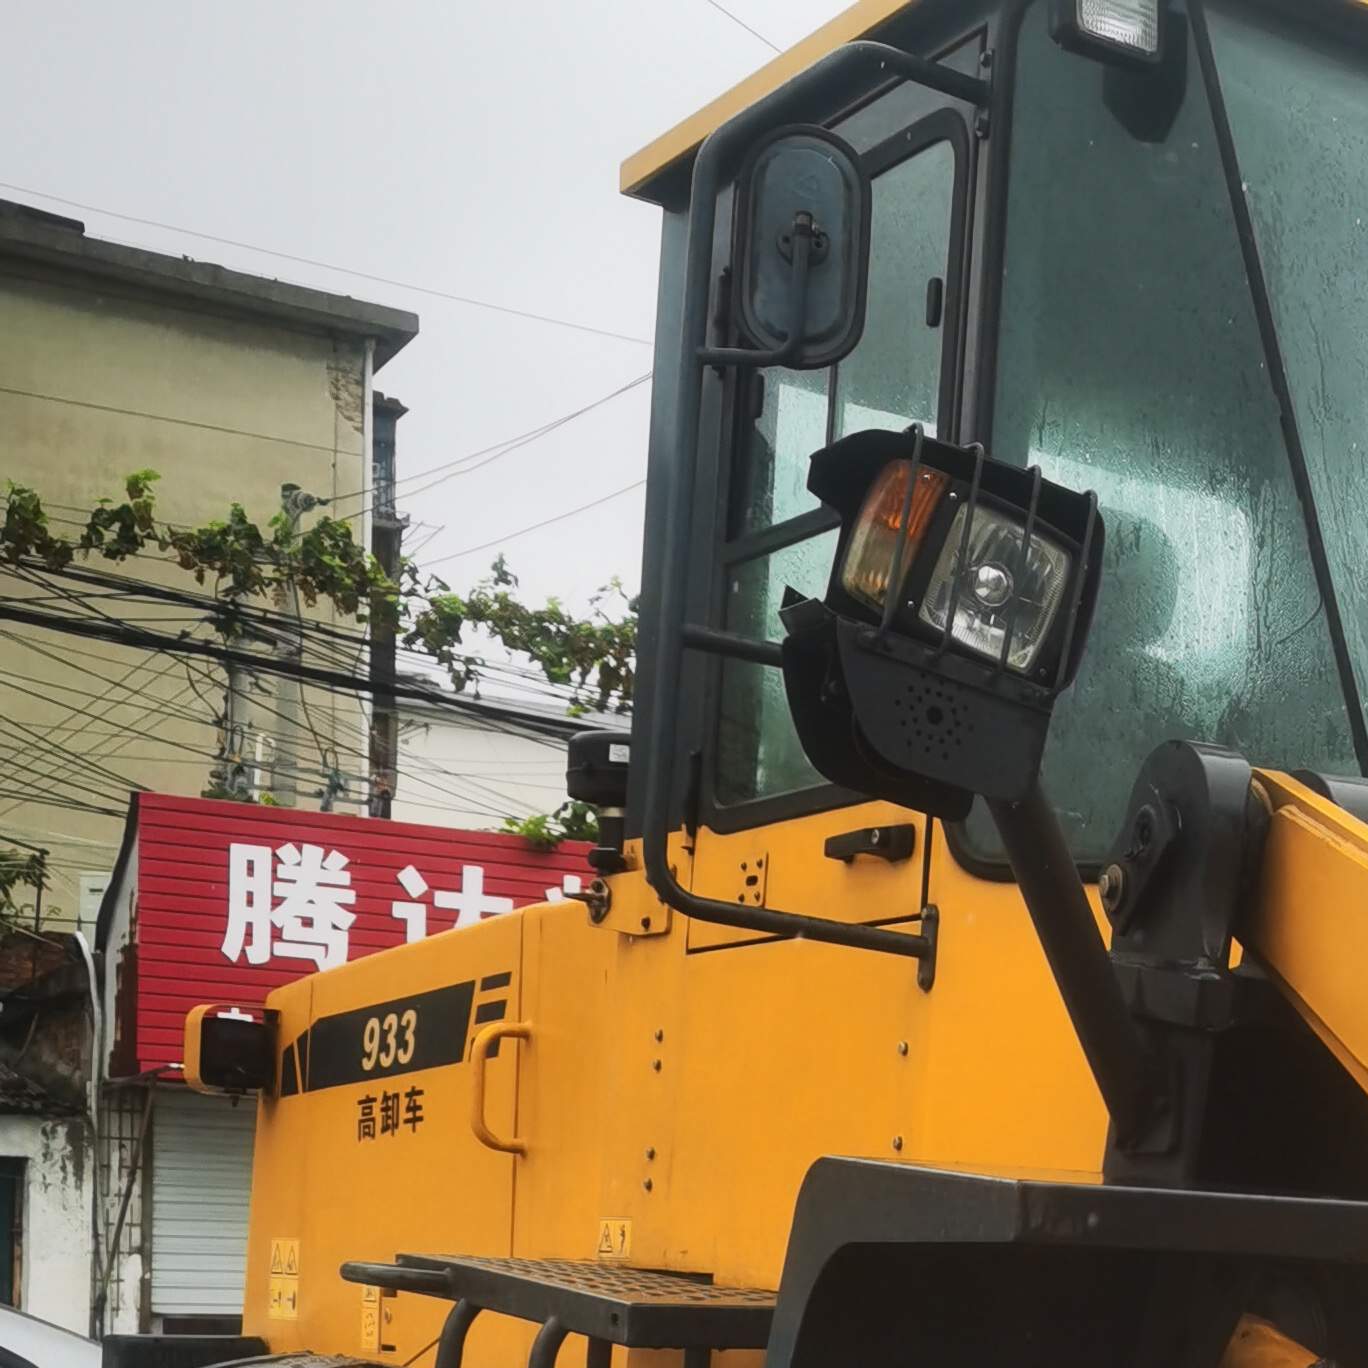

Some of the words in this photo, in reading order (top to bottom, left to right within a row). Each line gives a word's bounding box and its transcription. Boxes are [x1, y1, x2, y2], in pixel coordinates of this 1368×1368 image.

[361, 1009, 417, 1072] 933
[357, 1086, 425, 1142] 高卸车
